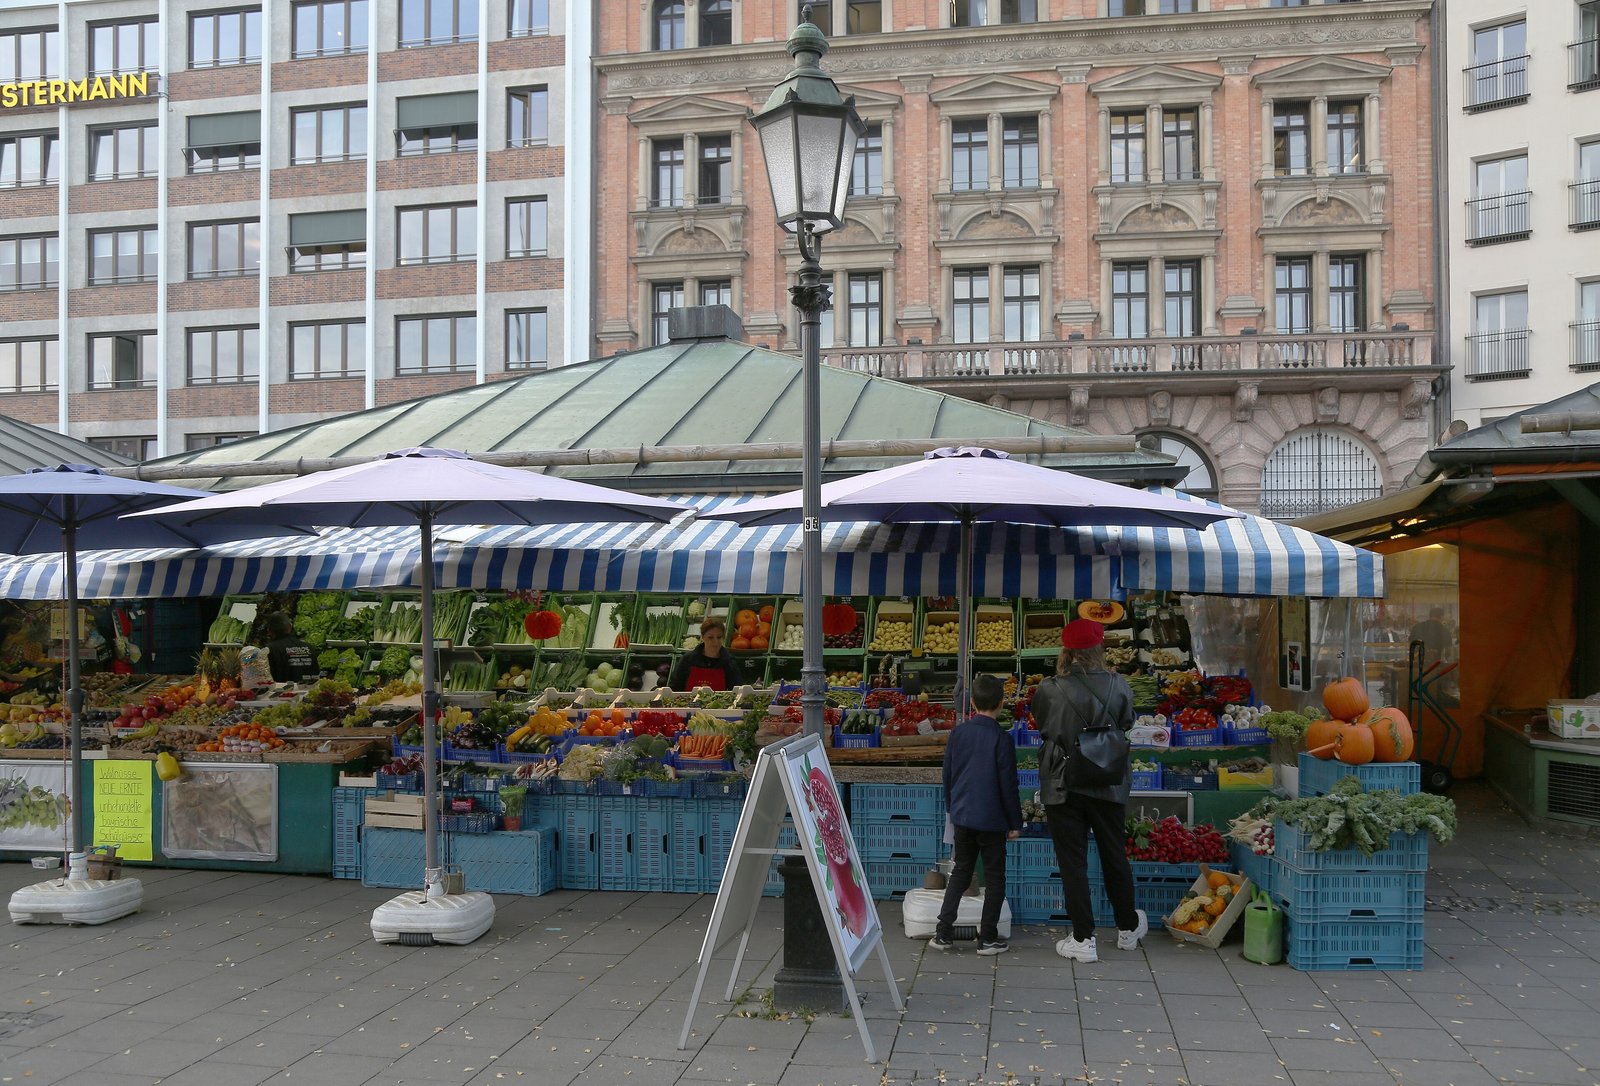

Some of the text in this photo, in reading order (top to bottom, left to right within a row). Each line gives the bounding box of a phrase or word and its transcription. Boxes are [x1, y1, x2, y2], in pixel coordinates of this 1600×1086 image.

[2, 72, 148, 108] STERMANN
[100, 783, 142, 794] NEUE ERNTE
